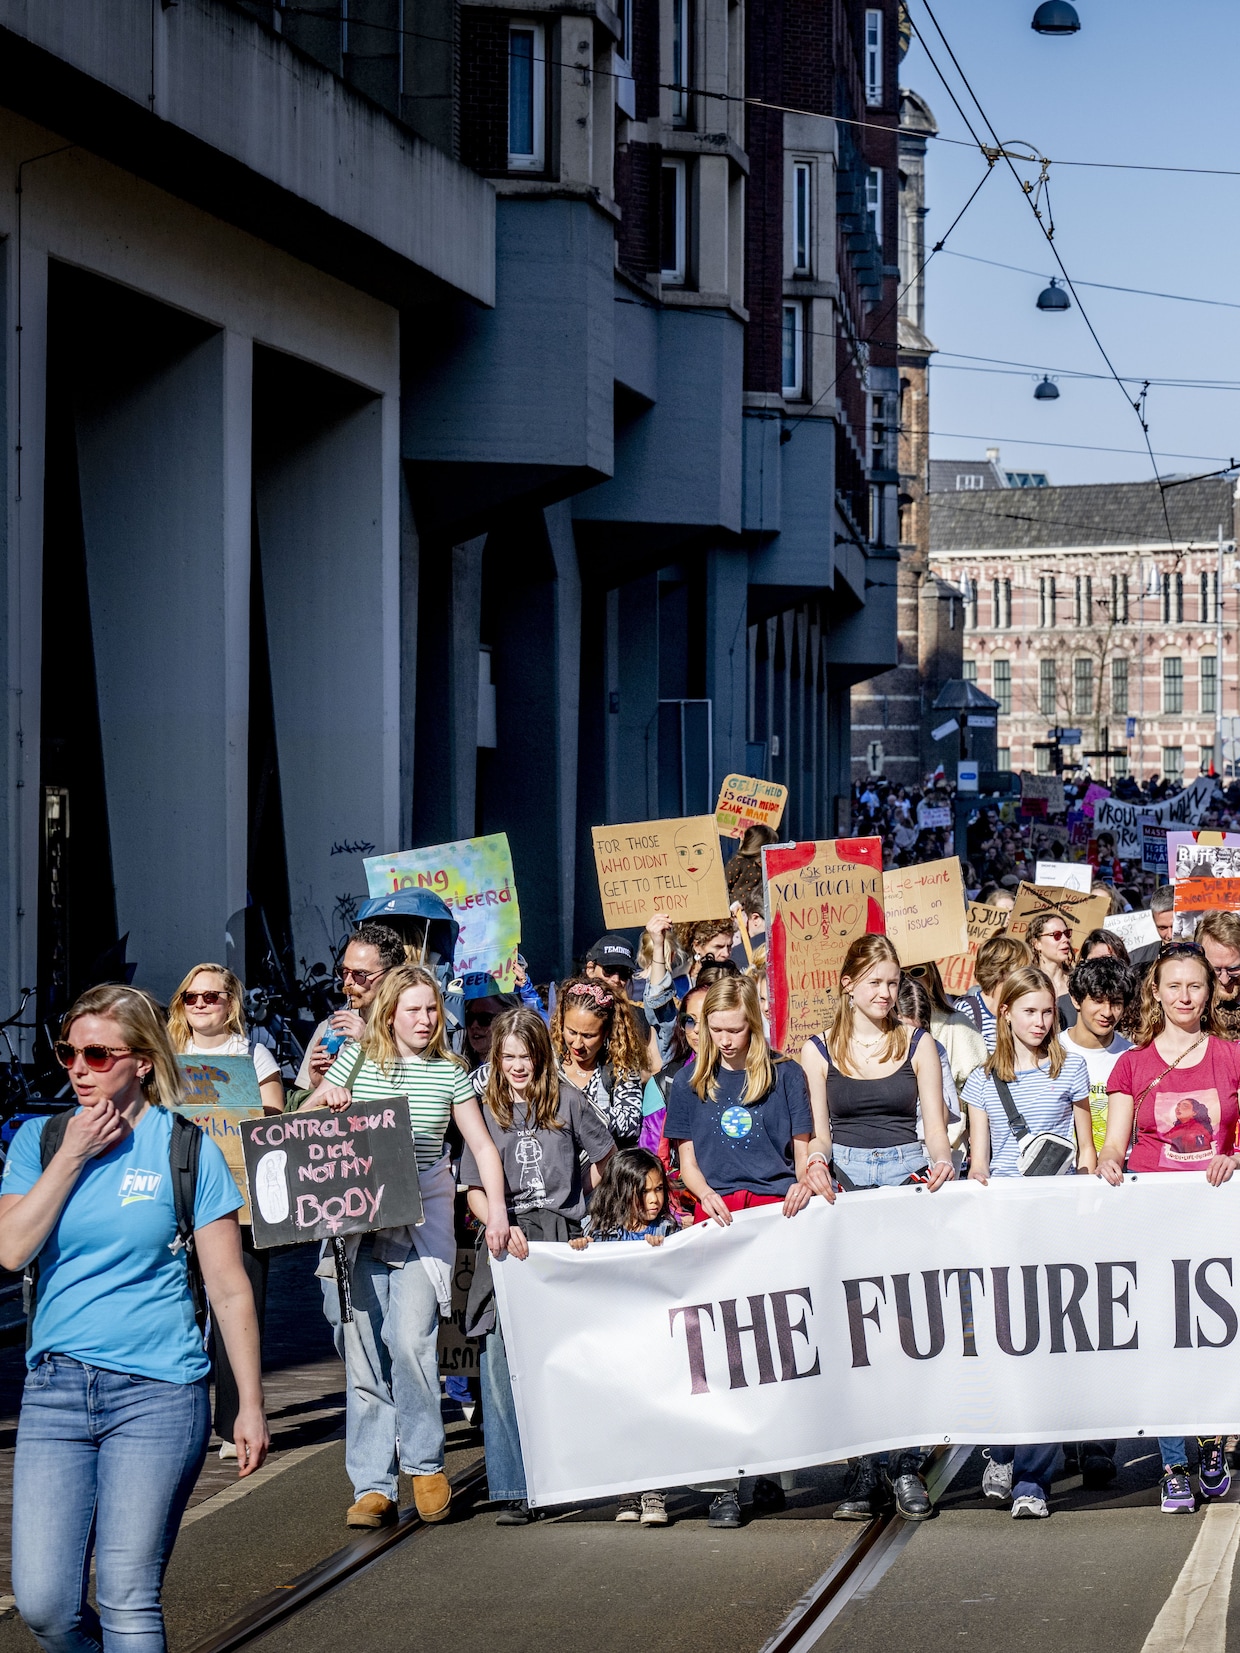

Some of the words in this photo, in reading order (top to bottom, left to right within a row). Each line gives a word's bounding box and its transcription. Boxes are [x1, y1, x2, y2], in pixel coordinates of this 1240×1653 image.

[597, 839, 622, 854] FOR
[625, 834, 661, 850] THOSE
[600, 856, 631, 874] WHO
[633, 853, 668, 871] DIDNT
[799, 866, 821, 879] ASK
[824, 863, 858, 875] BEFORE
[603, 879, 629, 897] GET
[631, 877, 650, 894] TO
[653, 874, 688, 891] TELL
[775, 882, 806, 903] YOU
[814, 879, 855, 897] TOUCH
[861, 878, 883, 895] ME
[606, 897, 647, 915] THEIR
[653, 894, 689, 912] STORY
[930, 899, 943, 909] on
[789, 906, 820, 931] NO
[831, 903, 859, 925] NO
[907, 914, 940, 931] issues
[789, 955, 807, 970] My
[790, 994, 808, 1010] Fuck
[812, 997, 825, 1005] the
[790, 1017, 821, 1032] Protect
[250, 1116, 348, 1146] CONTROL
[346, 1108, 396, 1132] YOUR
[309, 1139, 356, 1160] DICK
[298, 1161, 336, 1183] NOT
[340, 1155, 373, 1179] MY
[121, 1174, 160, 1192] FNV
[296, 1184, 385, 1231] BODY
[669, 1286, 822, 1396] THE
[842, 1260, 1139, 1368] FUTURE
[1173, 1256, 1239, 1349] IS
